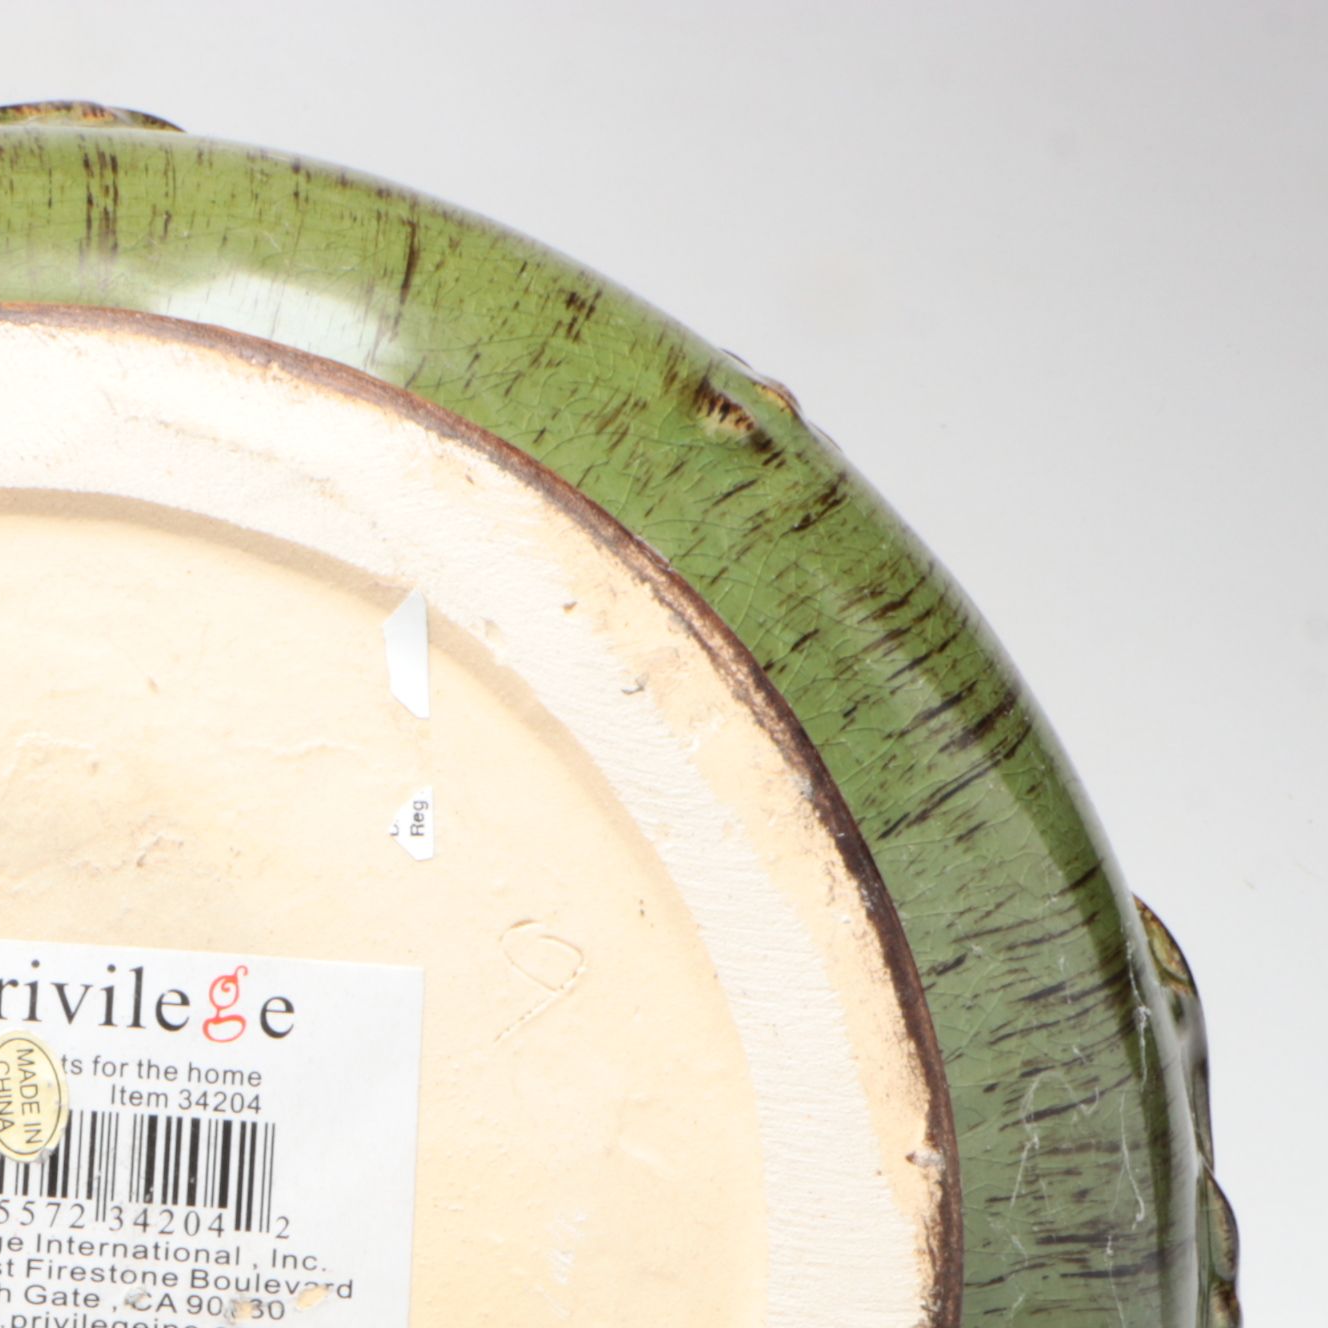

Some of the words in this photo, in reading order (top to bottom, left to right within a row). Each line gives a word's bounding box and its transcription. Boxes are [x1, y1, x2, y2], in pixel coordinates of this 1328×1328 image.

[16, 1048, 41, 1115] MADE
[93, 1054, 129, 1077] for
[136, 1059, 179, 1082] the
[187, 1061, 262, 1088] home
[111, 1084, 169, 1108] Item
[178, 1088, 262, 1114] 34204
[23, 1122, 44, 1144] IN
[25, 1258, 179, 1288] Firestone
[271, 1248, 327, 1272] Inc.
